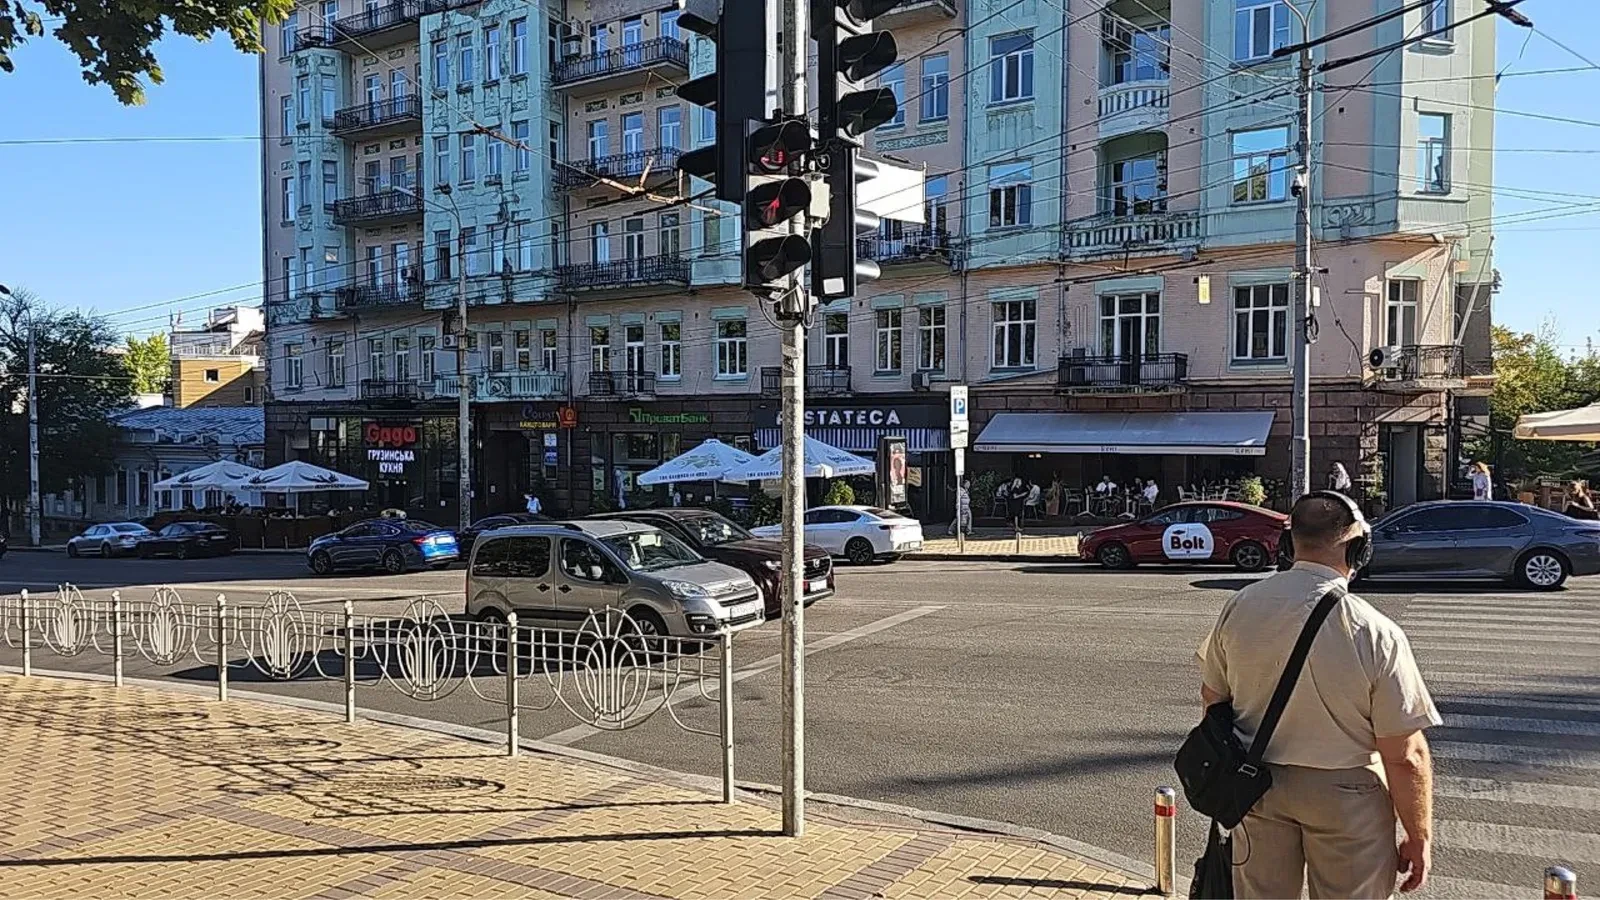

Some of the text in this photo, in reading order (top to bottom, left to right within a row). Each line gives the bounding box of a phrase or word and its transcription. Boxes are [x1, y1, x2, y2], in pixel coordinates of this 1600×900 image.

[776, 409, 901, 425] PSTATECA
[368, 449, 415, 461] ГРУЗИНСЬКА
[379, 462, 403, 473] КУХНЯ
[1170, 535, 1205, 550] Bolt
